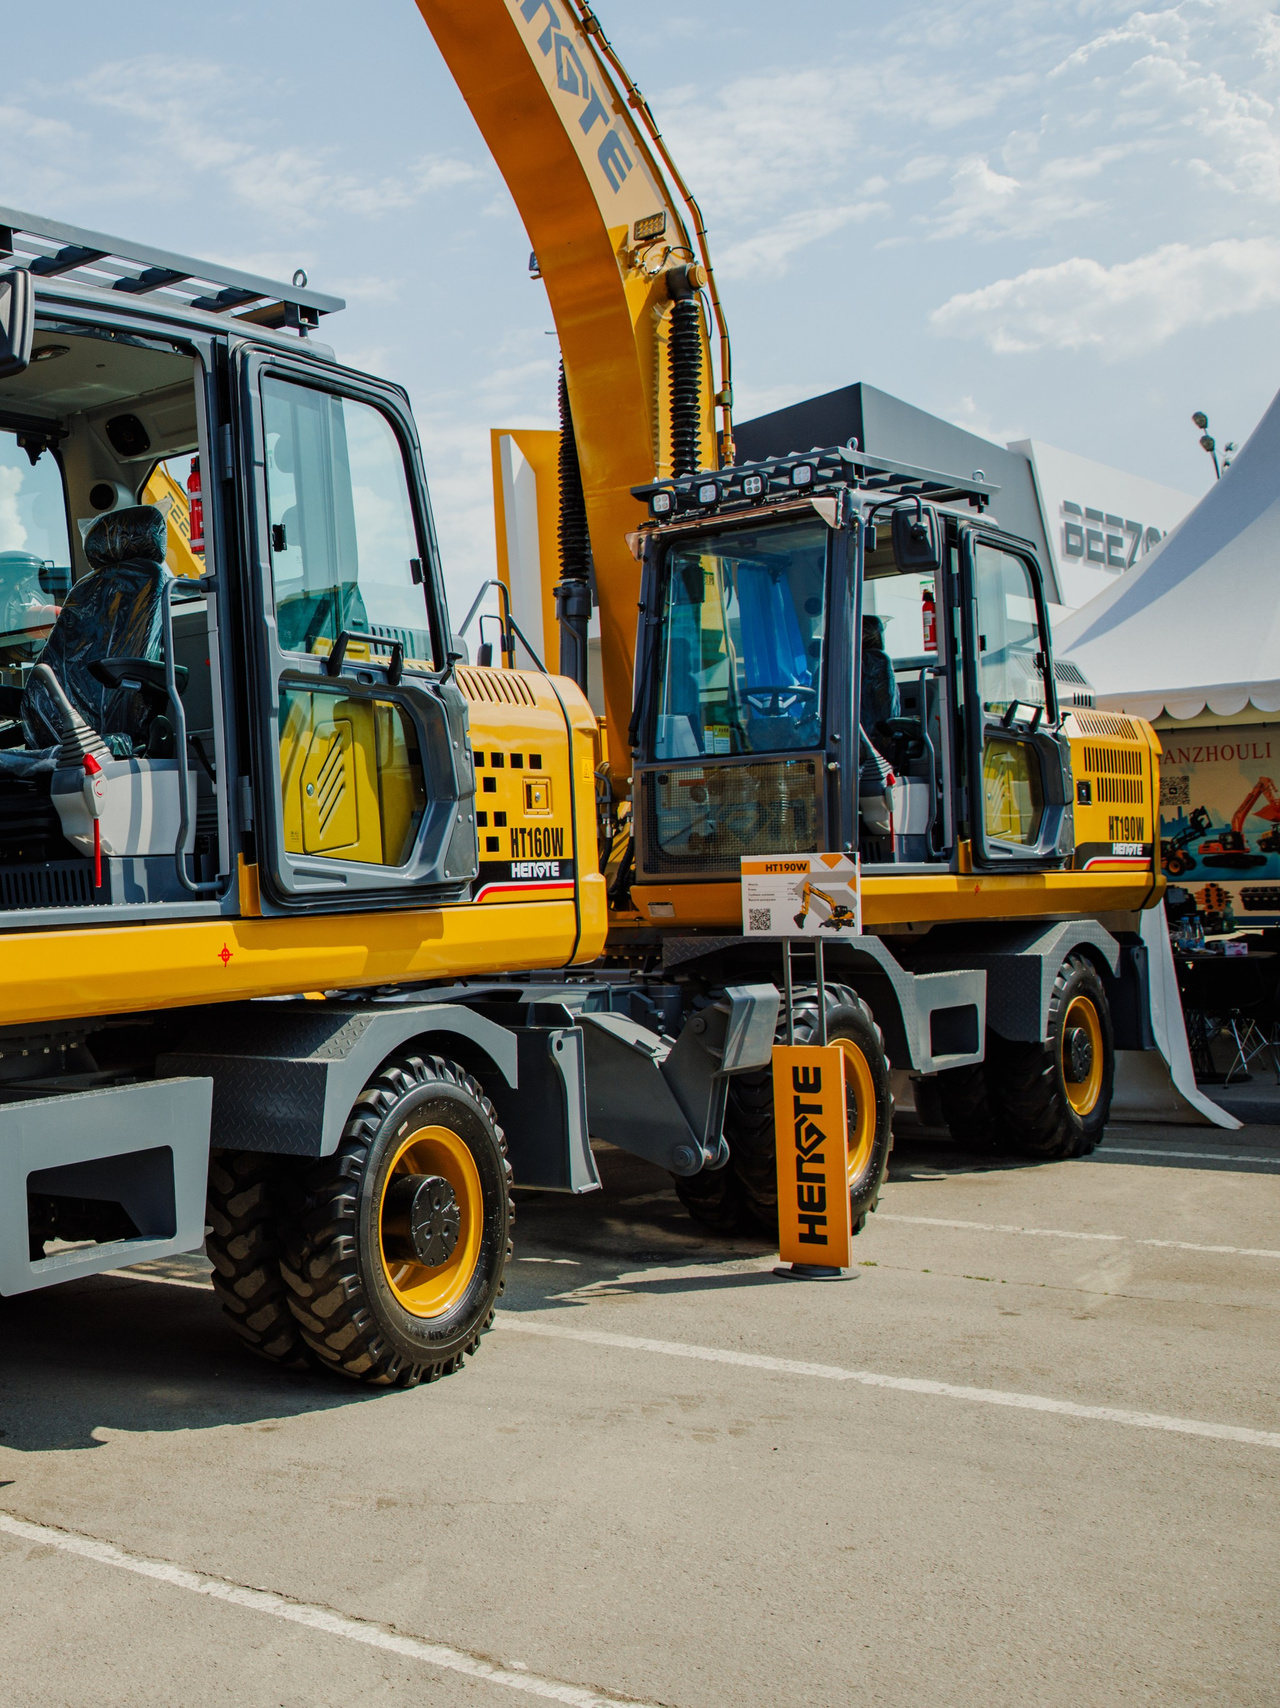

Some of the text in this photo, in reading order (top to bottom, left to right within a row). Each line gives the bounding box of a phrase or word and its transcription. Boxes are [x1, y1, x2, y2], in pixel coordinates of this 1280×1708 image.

[1063, 500, 1167, 569] BEEZ
[1160, 742, 1272, 766] ANZHOULI
[1109, 815, 1144, 841] HT190W
[510, 827, 563, 858] HT160W
[511, 862, 560, 878] HENGTE
[765, 863, 808, 872] HT190W
[792, 1066, 827, 1245] HENGTE
